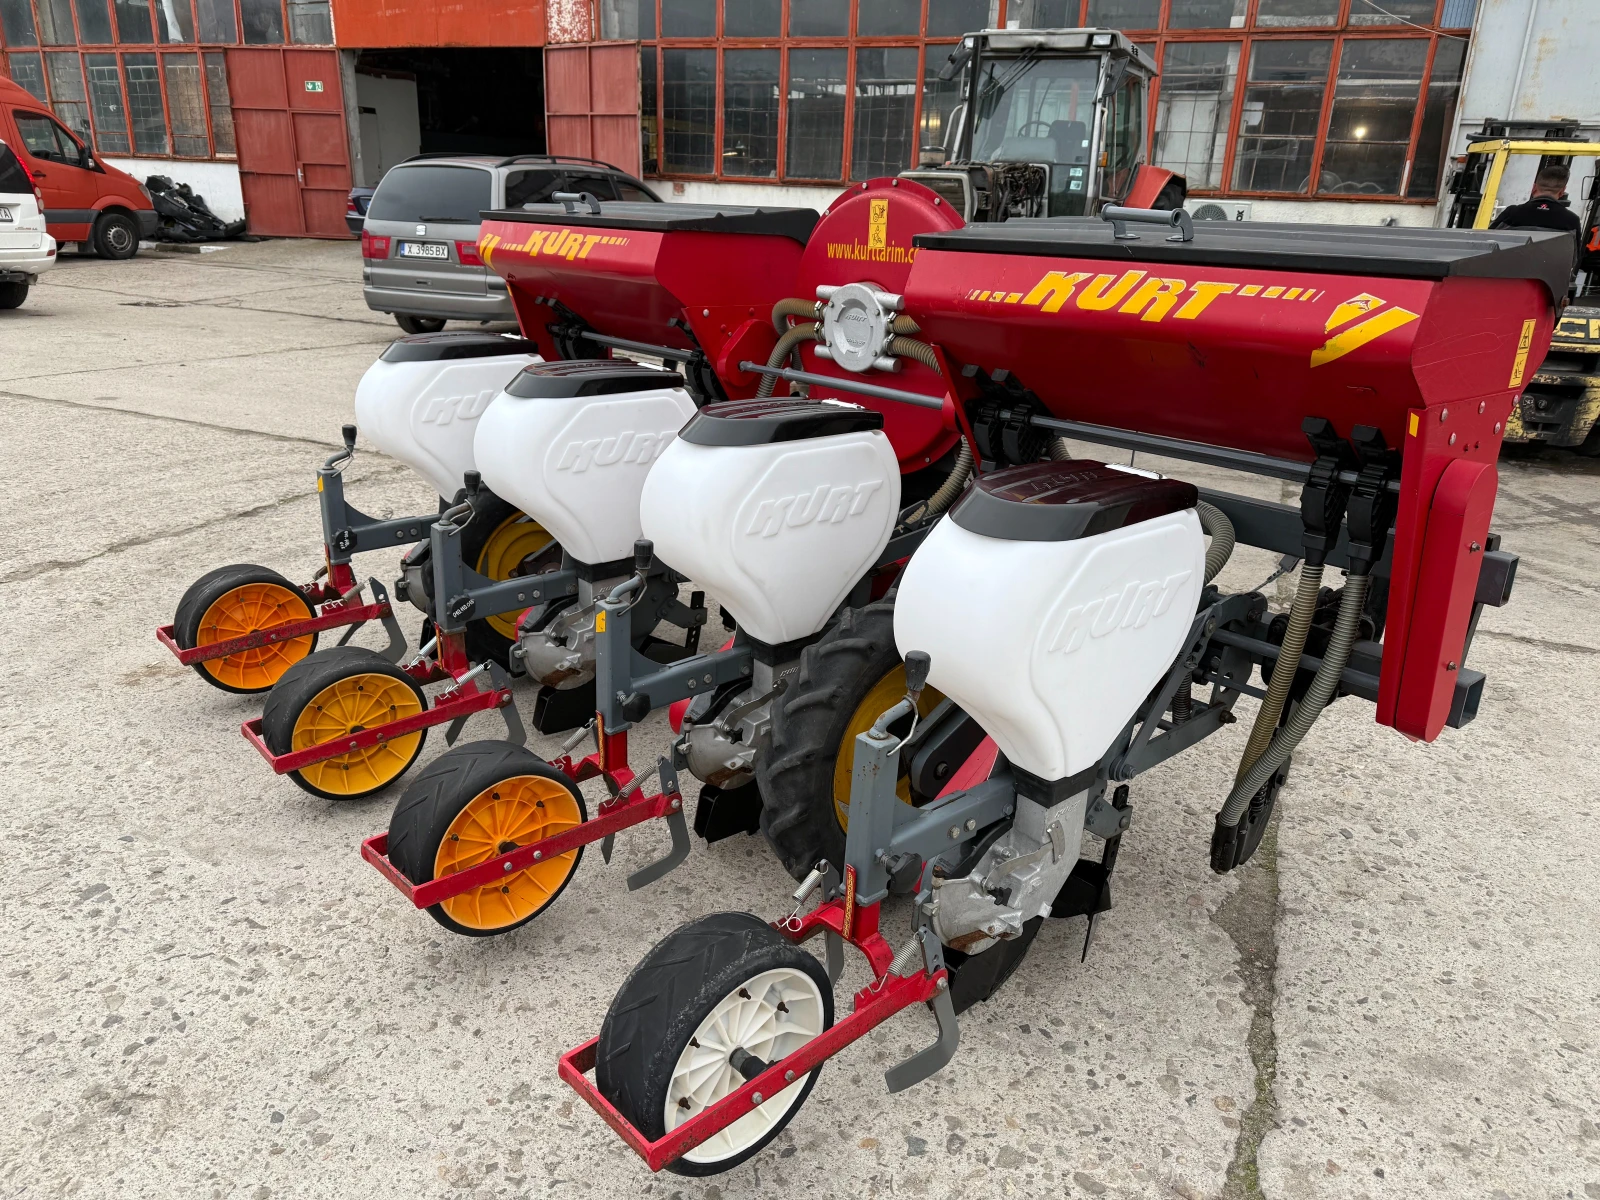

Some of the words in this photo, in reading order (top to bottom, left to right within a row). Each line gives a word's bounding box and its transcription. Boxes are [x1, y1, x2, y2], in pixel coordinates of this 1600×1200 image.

[522, 229, 601, 260] KURT
[1021, 270, 1240, 322] KURT
[746, 479, 883, 538] KURT
[1048, 569, 1192, 654] KURT
